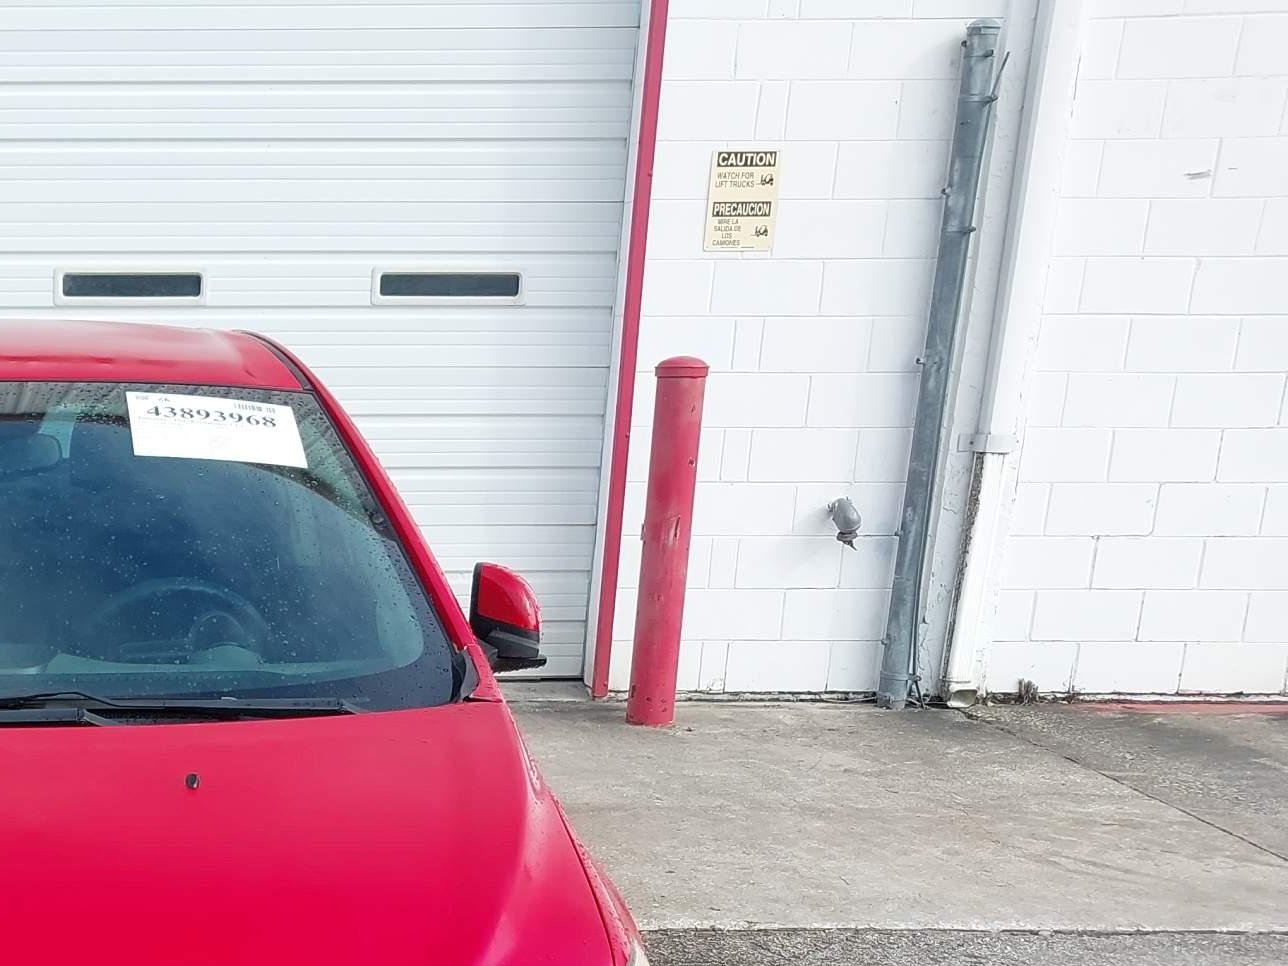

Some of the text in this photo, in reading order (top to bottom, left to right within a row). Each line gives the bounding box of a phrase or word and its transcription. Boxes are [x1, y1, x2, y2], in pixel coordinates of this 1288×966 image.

[718, 153, 776, 166] CAUTION
[713, 203, 770, 216] PRECAUCION
[145, 405, 277, 428] 43893968
